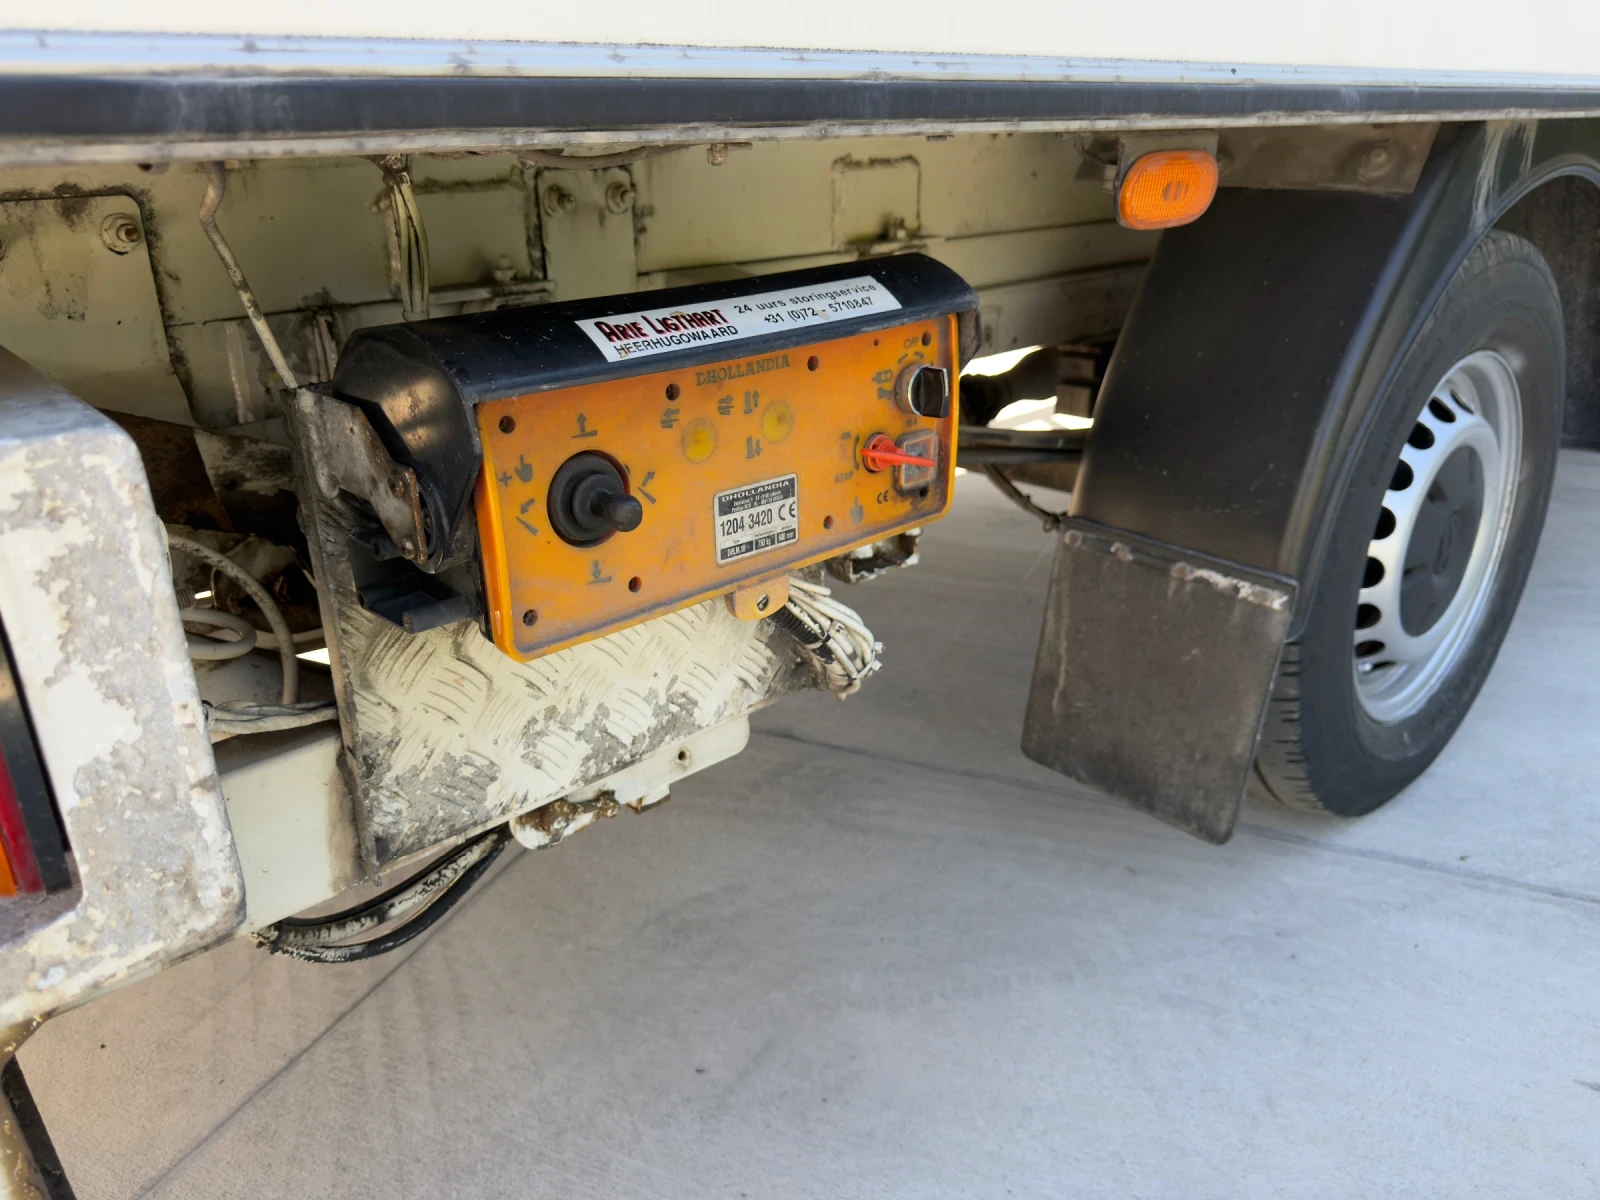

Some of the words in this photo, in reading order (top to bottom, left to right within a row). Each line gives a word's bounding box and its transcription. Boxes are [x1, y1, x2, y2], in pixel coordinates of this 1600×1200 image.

[733, 304, 753, 314] 24
[755, 300, 787, 311] uurs
[789, 283, 877, 304] storingservice
[763, 312, 785, 324] +31
[788, 307, 818, 322] (0)72
[828, 296, 874, 313] 5710847
[594, 321, 649, 343] ARIE
[613, 325, 739, 355] HEERHUGOWAARD
[904, 336, 920, 350] OFF
[695, 354, 790, 387] DHOLLANDIA
[834, 470, 854, 484] STOP
[721, 480, 790, 503] DHOLLANDIA
[720, 516, 745, 537] 1204
[748, 508, 773, 530] 3420
